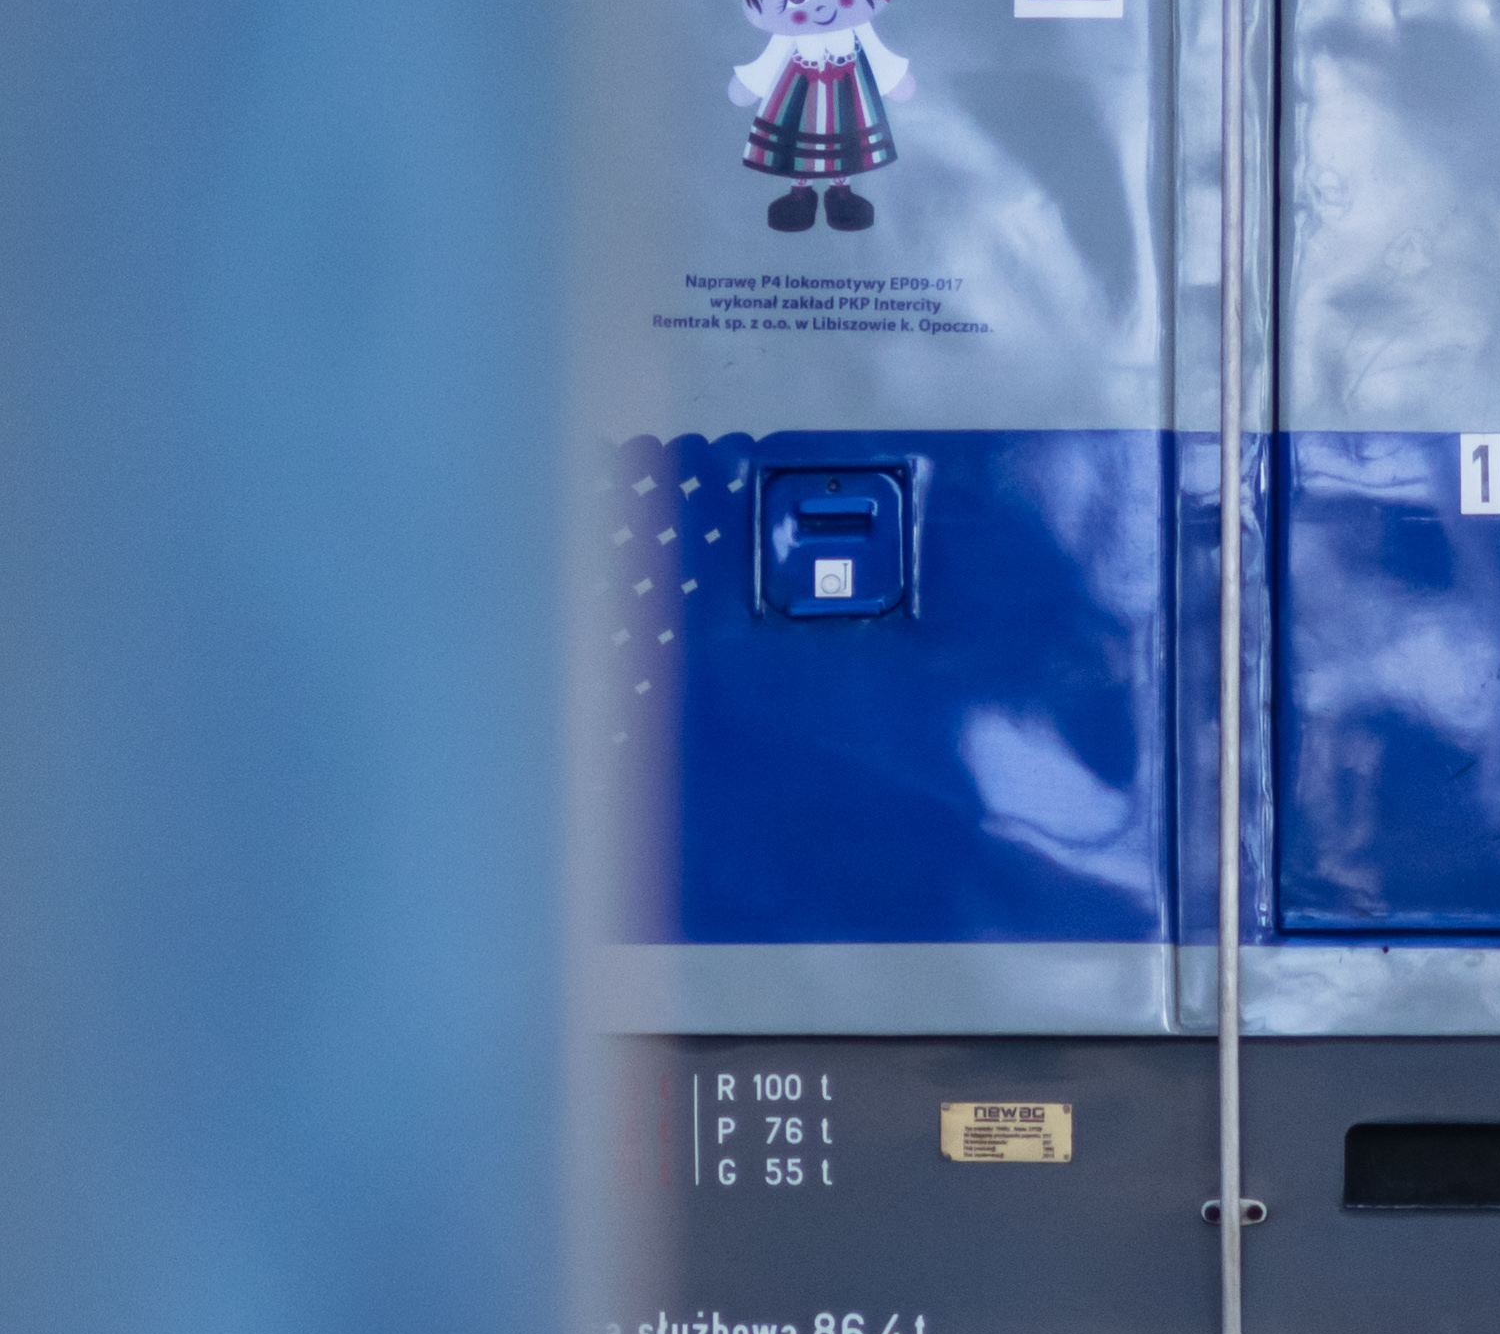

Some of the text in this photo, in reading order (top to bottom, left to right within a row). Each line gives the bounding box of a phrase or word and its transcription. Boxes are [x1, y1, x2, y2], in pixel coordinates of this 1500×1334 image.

[685, 274, 964, 294] Naprawę P4 lokomotywy EP09-017
[710, 296, 941, 315] wykonał zakład PKP Intercity
[652, 315, 721, 329] Remtrak
[724, 318, 747, 332] sp.
[750, 320, 759, 330] z
[762, 319, 791, 330] o.o.
[795, 320, 809, 330] w
[812, 318, 897, 332] Libiszowie
[900, 319, 914, 331] k.
[1472, 444, 1490, 503] 1
[717, 1074, 833, 1100] R 100 t
[717, 1117, 833, 1144] P 76 t
[718, 1158, 833, 1185] G 55 t
